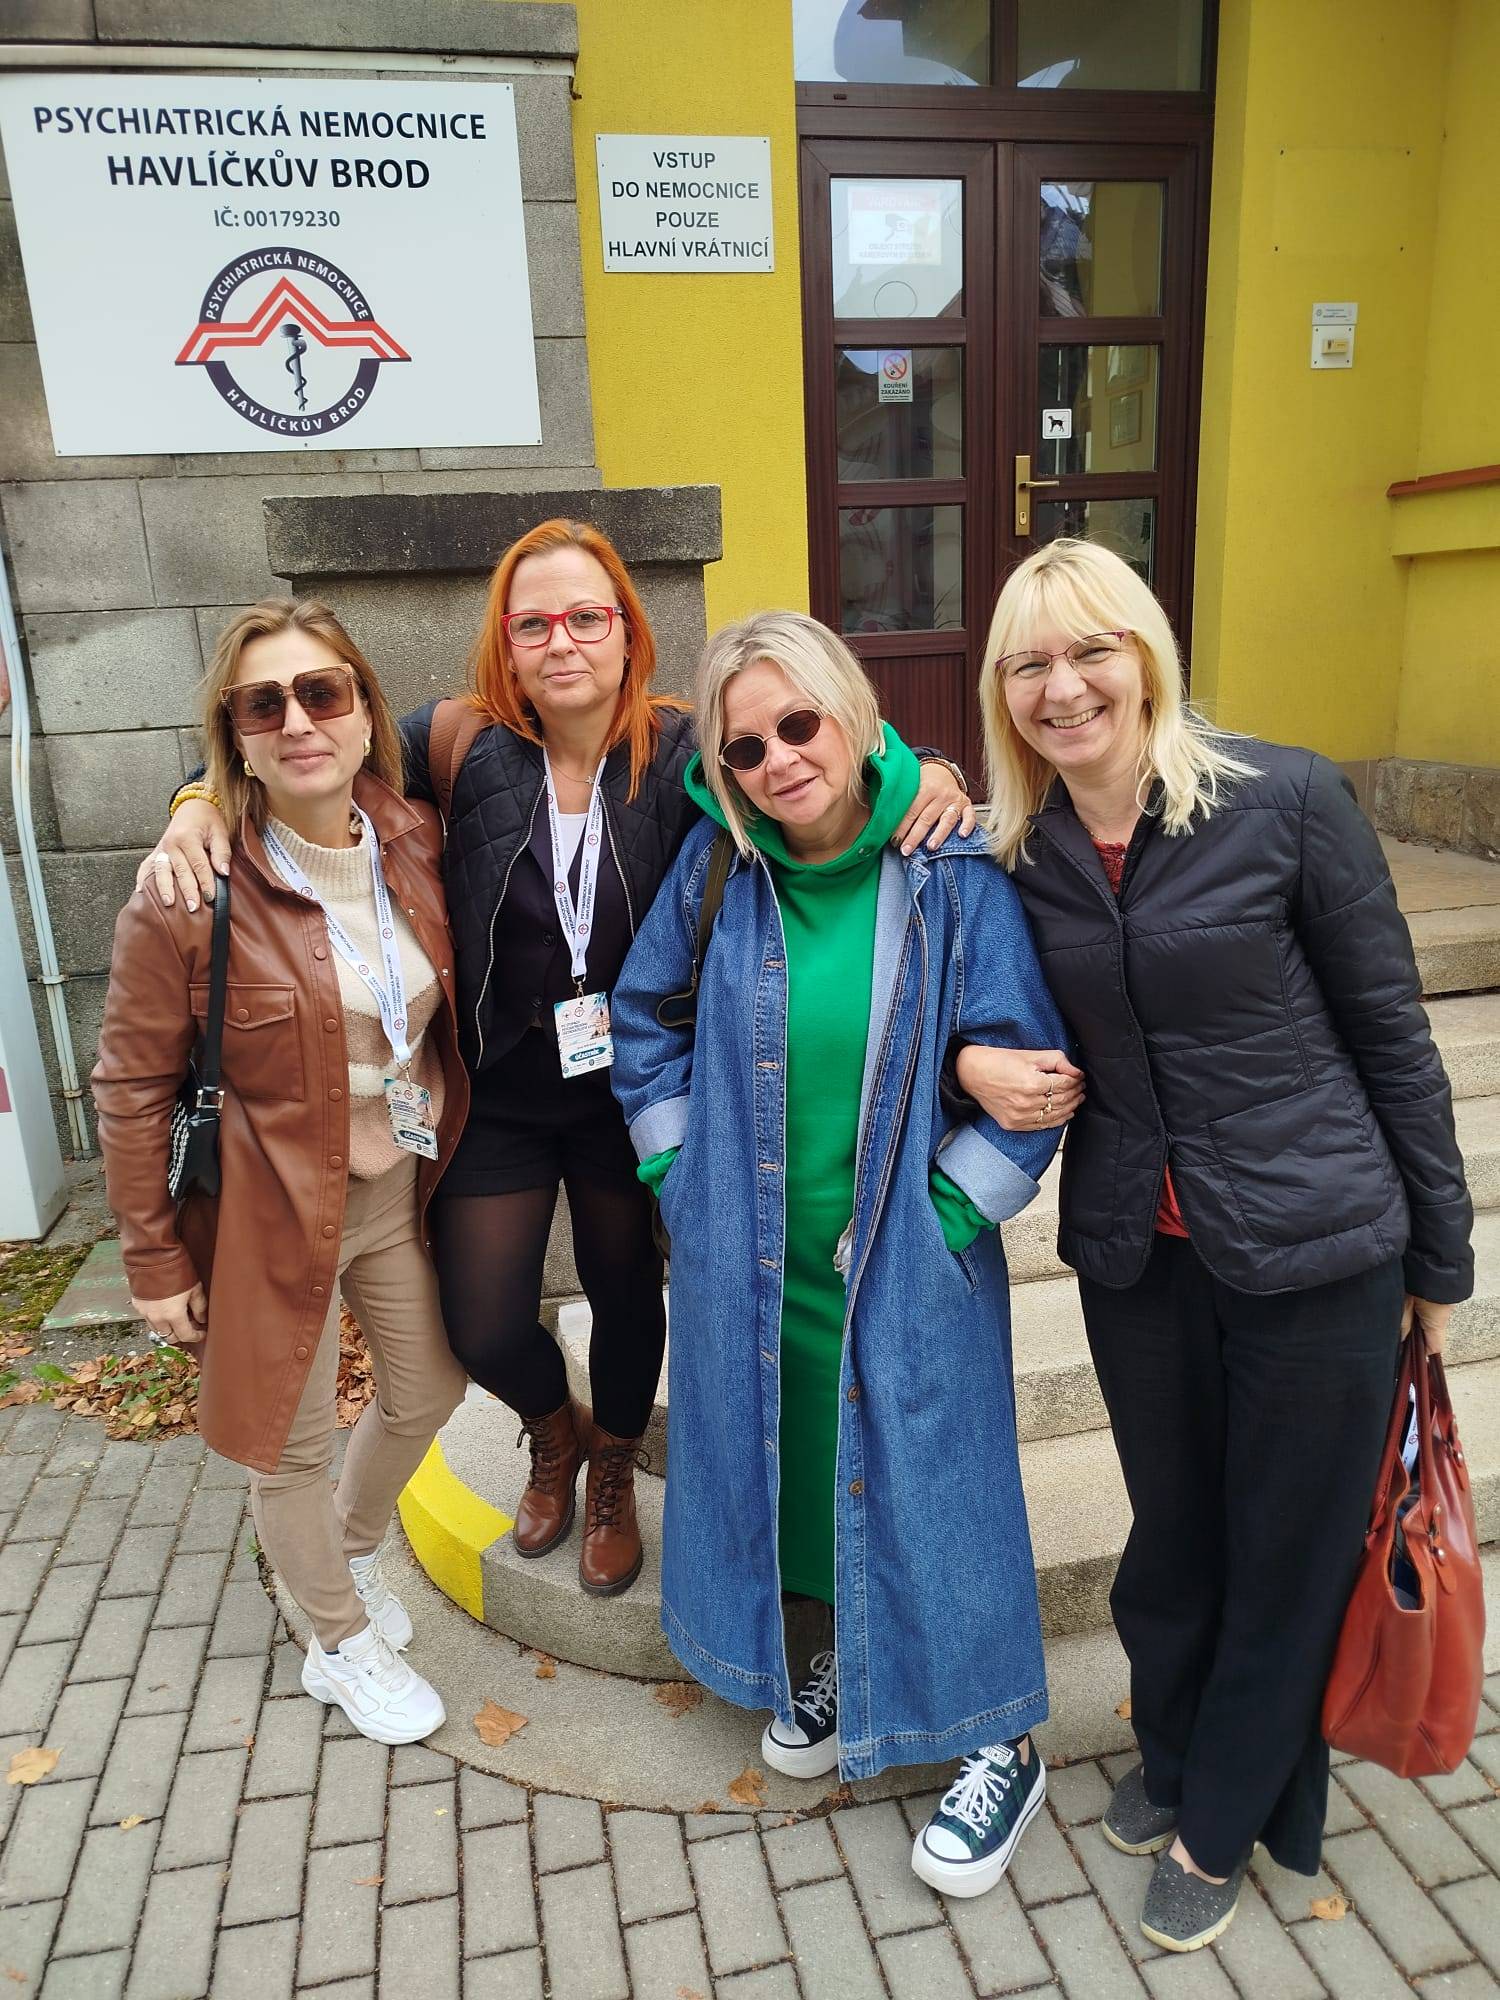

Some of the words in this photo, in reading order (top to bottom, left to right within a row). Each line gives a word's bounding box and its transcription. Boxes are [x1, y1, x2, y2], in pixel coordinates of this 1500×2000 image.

[33, 104, 292, 137] PSYCHIATRICKÁ
[300, 111, 487, 140] NEMOCNICE
[107, 149, 319, 187] HAVLÍČKŮV
[331, 159, 430, 189] BROD
[653, 152, 716, 169] VSTUP
[612, 181, 640, 198] DO
[646, 182, 760, 199] NEMOCNICE
[243, 209, 341, 228] 00179230
[656, 211, 719, 228] POUZE
[608, 237, 676, 257] HLAVNÍ
[682, 236, 769, 258] VRÁTNICÍ
[205, 251, 293, 320] PSYCHIATRICKÁ
[297, 255, 369, 319] NEMOCNICE
[226, 388, 323, 432] HAVLÍČKŮV
[329, 387, 366, 424] BROD
